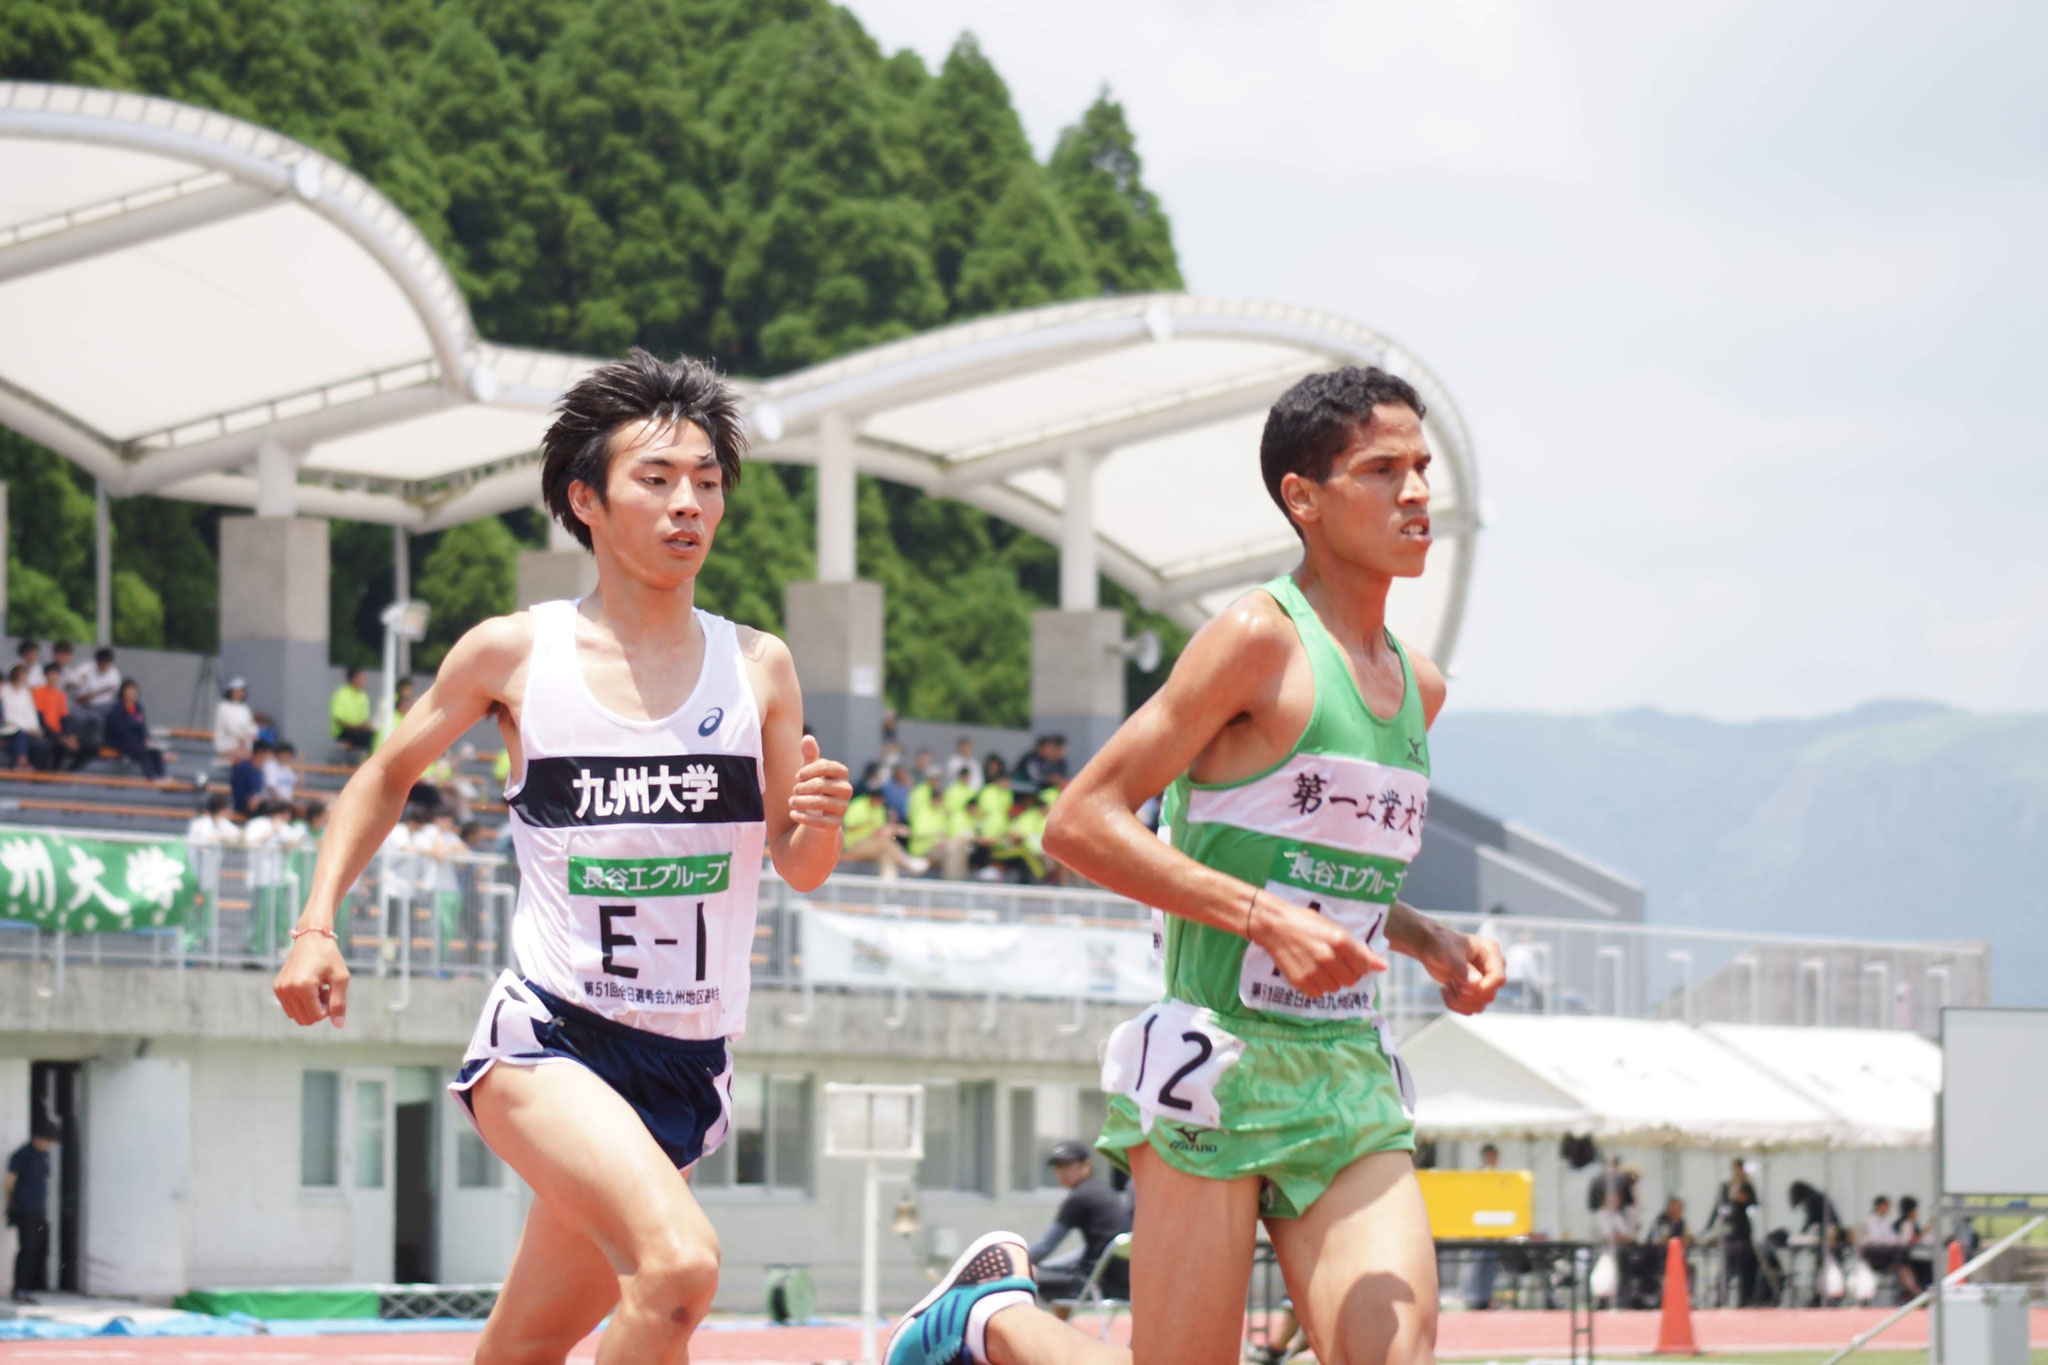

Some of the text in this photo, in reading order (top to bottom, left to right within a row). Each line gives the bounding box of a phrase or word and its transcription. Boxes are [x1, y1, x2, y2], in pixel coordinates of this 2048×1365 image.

[573, 764, 719, 819] 九州大学
[583, 860, 728, 892] 長谷工グループ
[1136, 1013, 1213, 1112] 12
